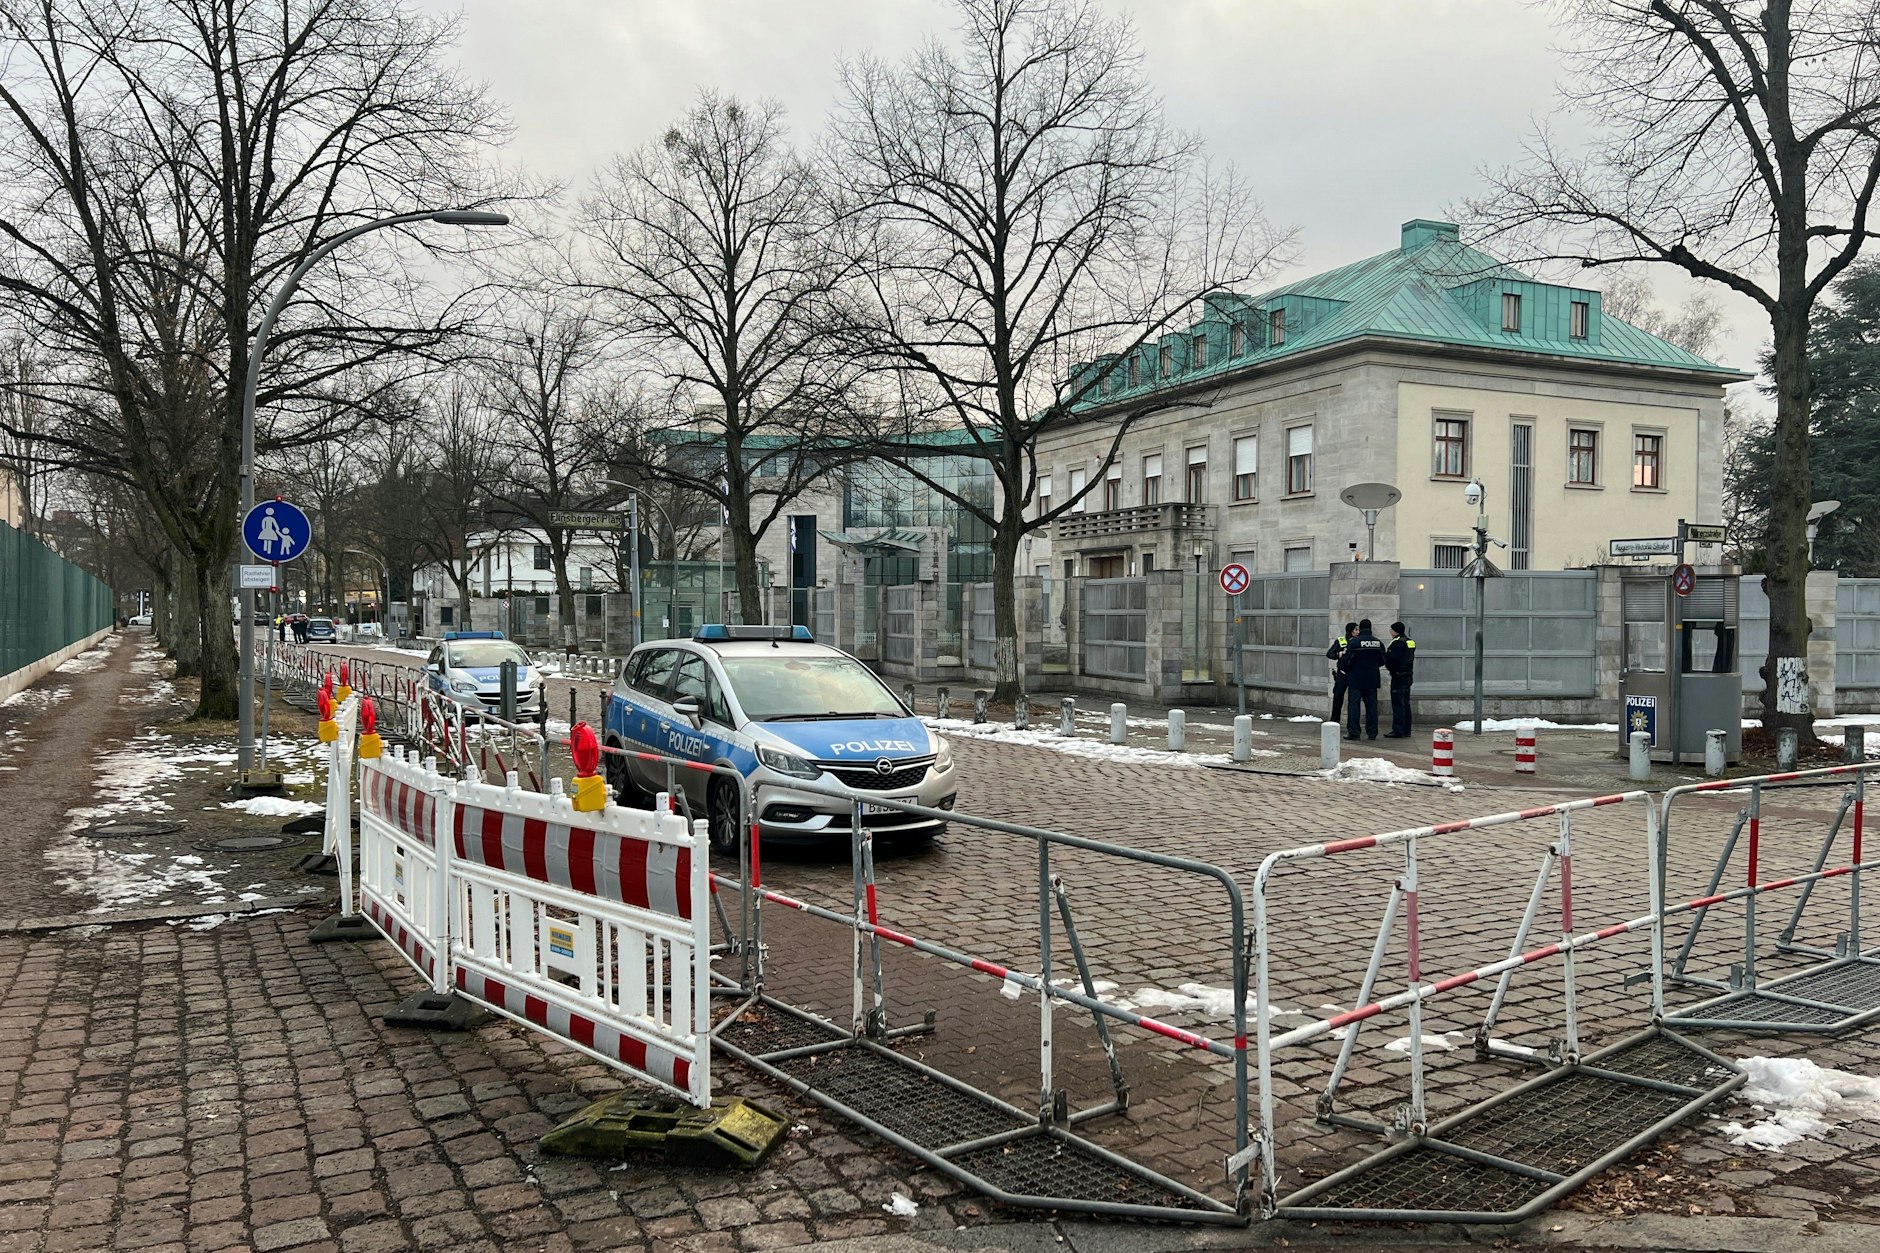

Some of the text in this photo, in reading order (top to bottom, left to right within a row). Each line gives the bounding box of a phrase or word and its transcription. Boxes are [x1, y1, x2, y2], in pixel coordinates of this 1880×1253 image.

[550, 512, 600, 525] Flinsberger
[1626, 697, 1654, 707] POLIZEI
[668, 731, 703, 757] POLIZEI
[829, 740, 916, 755] POLIZEI
